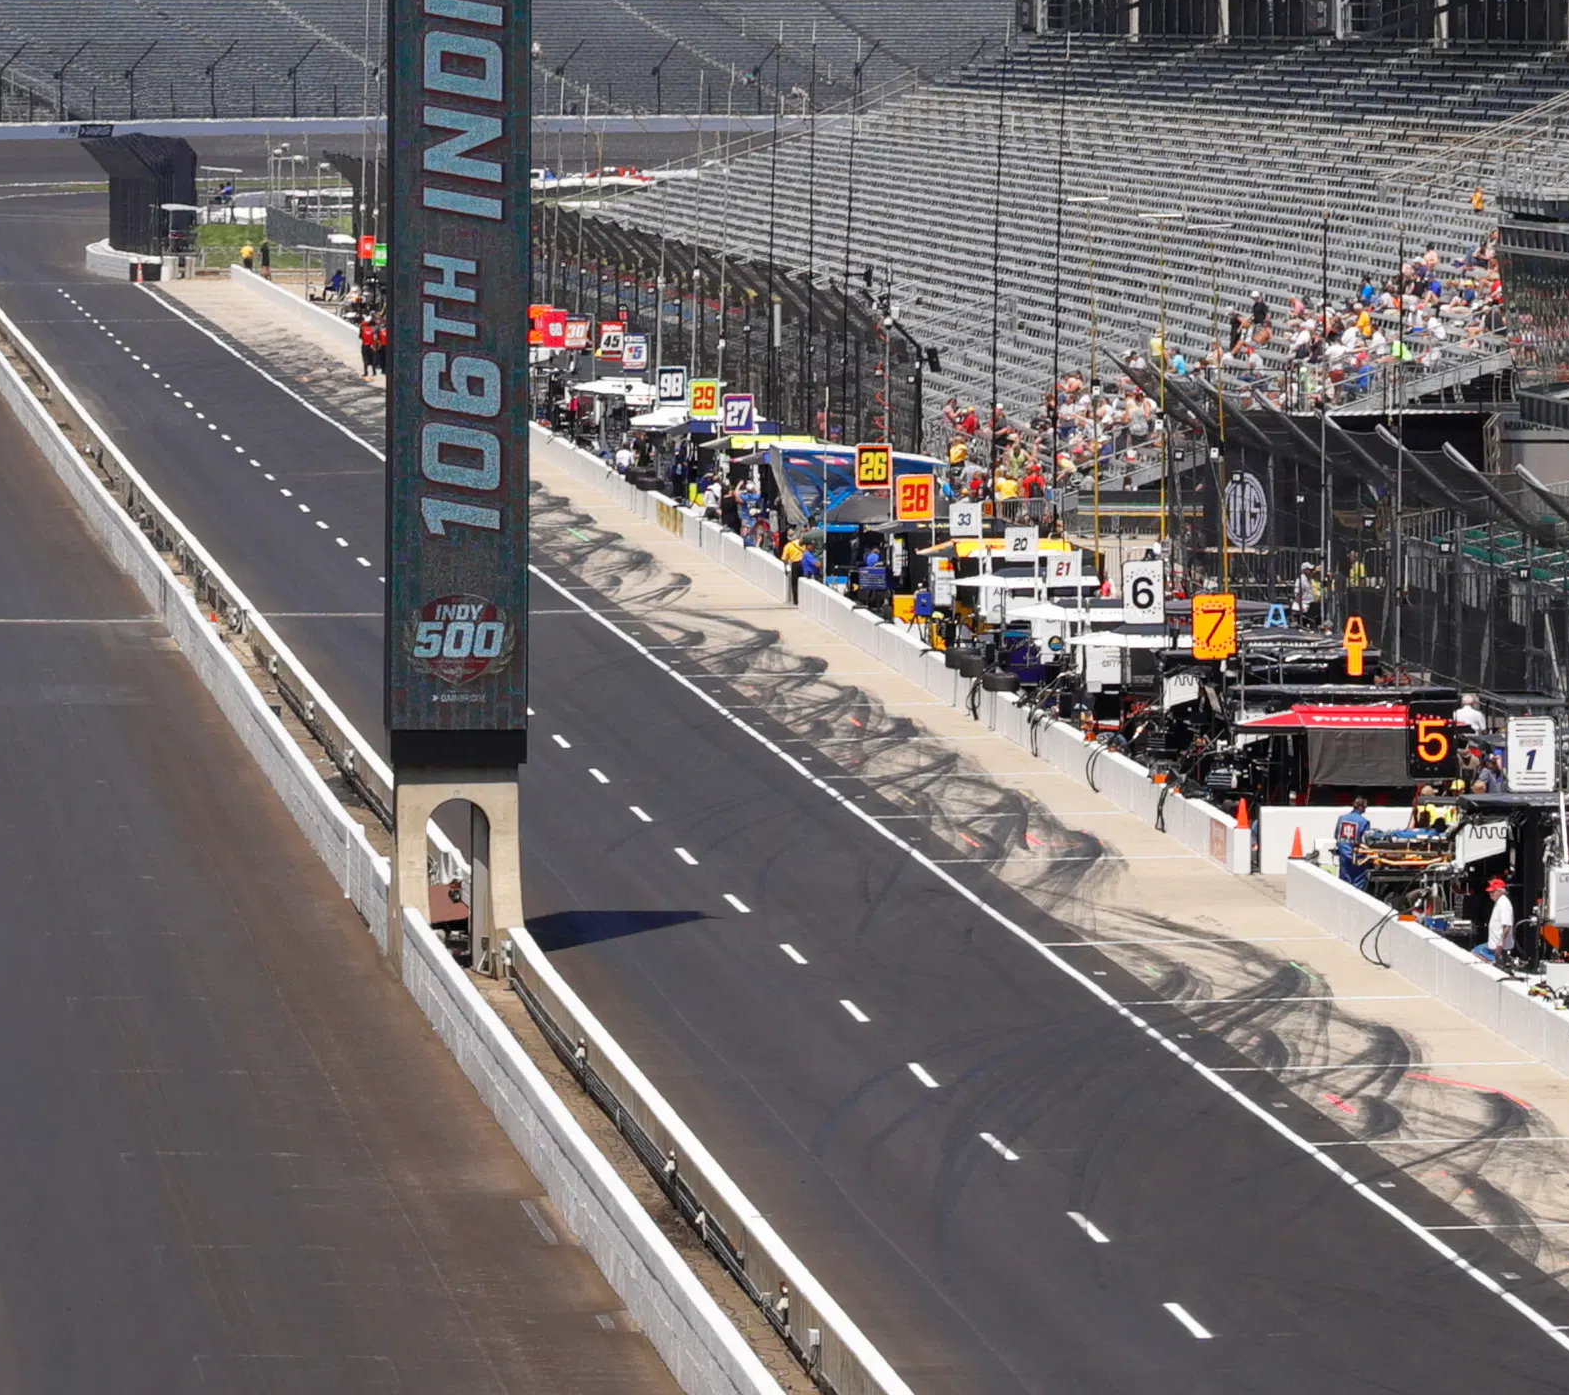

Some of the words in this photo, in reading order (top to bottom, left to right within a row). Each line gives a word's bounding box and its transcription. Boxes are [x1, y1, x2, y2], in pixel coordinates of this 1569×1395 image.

[567, 324, 585, 338] 30
[603, 335, 620, 348] 45
[421, 252, 502, 538] 106TH
[660, 373, 683, 397] 98
[693, 386, 715, 410] 29
[726, 401, 751, 427] 27
[860, 452, 887, 481] 26
[902, 483, 929, 512] 28
[957, 513, 972, 526] 33
[1013, 537, 1028, 551] 20
[1056, 562, 1071, 576] 21
[1132, 576, 1154, 609] 6
[435, 604, 483, 620] INDY
[1201, 608, 1226, 646] 7
[413, 621, 504, 658] 500
[1417, 719, 1449, 762] 5
[1526, 749, 1537, 771] 1
